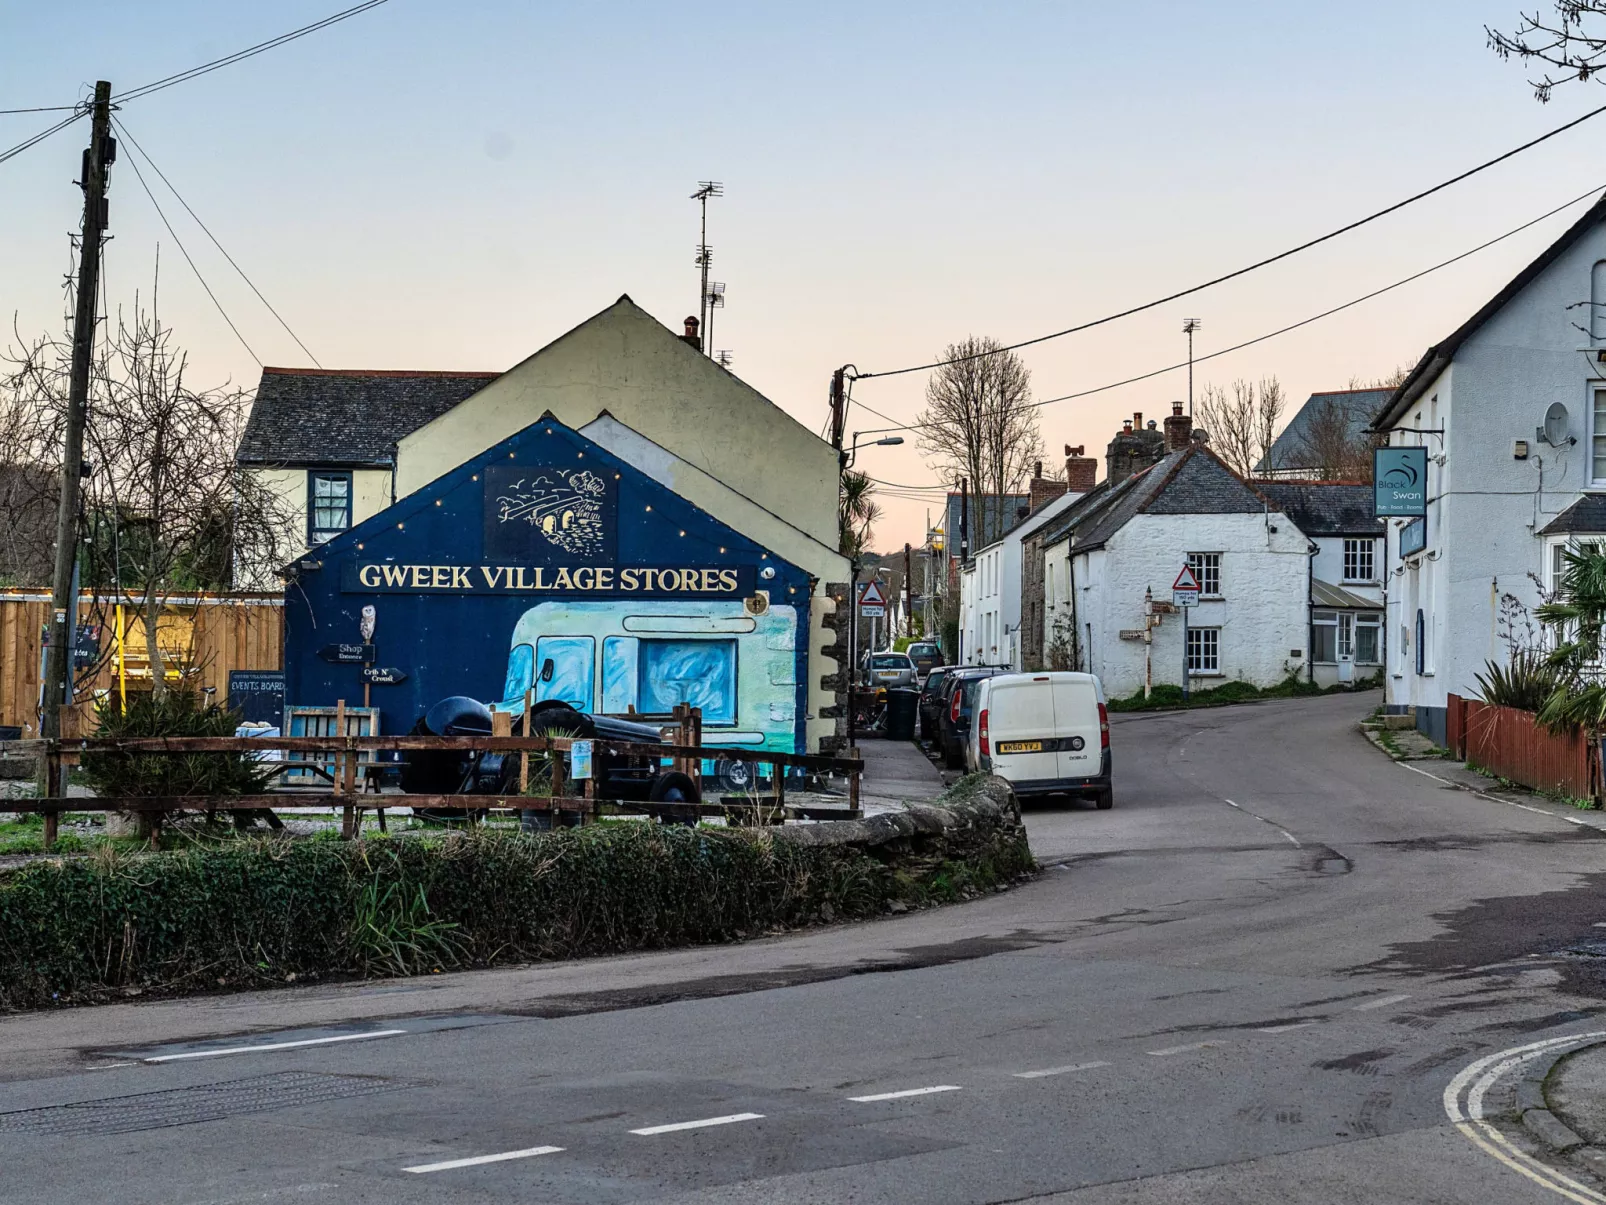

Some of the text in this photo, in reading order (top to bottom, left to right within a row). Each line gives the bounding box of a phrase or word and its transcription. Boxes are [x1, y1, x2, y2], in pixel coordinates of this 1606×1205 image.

[1378, 480, 1407, 489] Black
[1392, 491, 1421, 500] Swan
[359, 564, 738, 592] GWEEK VILLAGE STORES
[339, 644, 363, 654] Shop
[364, 668, 379, 676] Crib
[231, 681, 285, 690] EVENTS BOARD
[1024, 741, 1039, 751] YVJ
